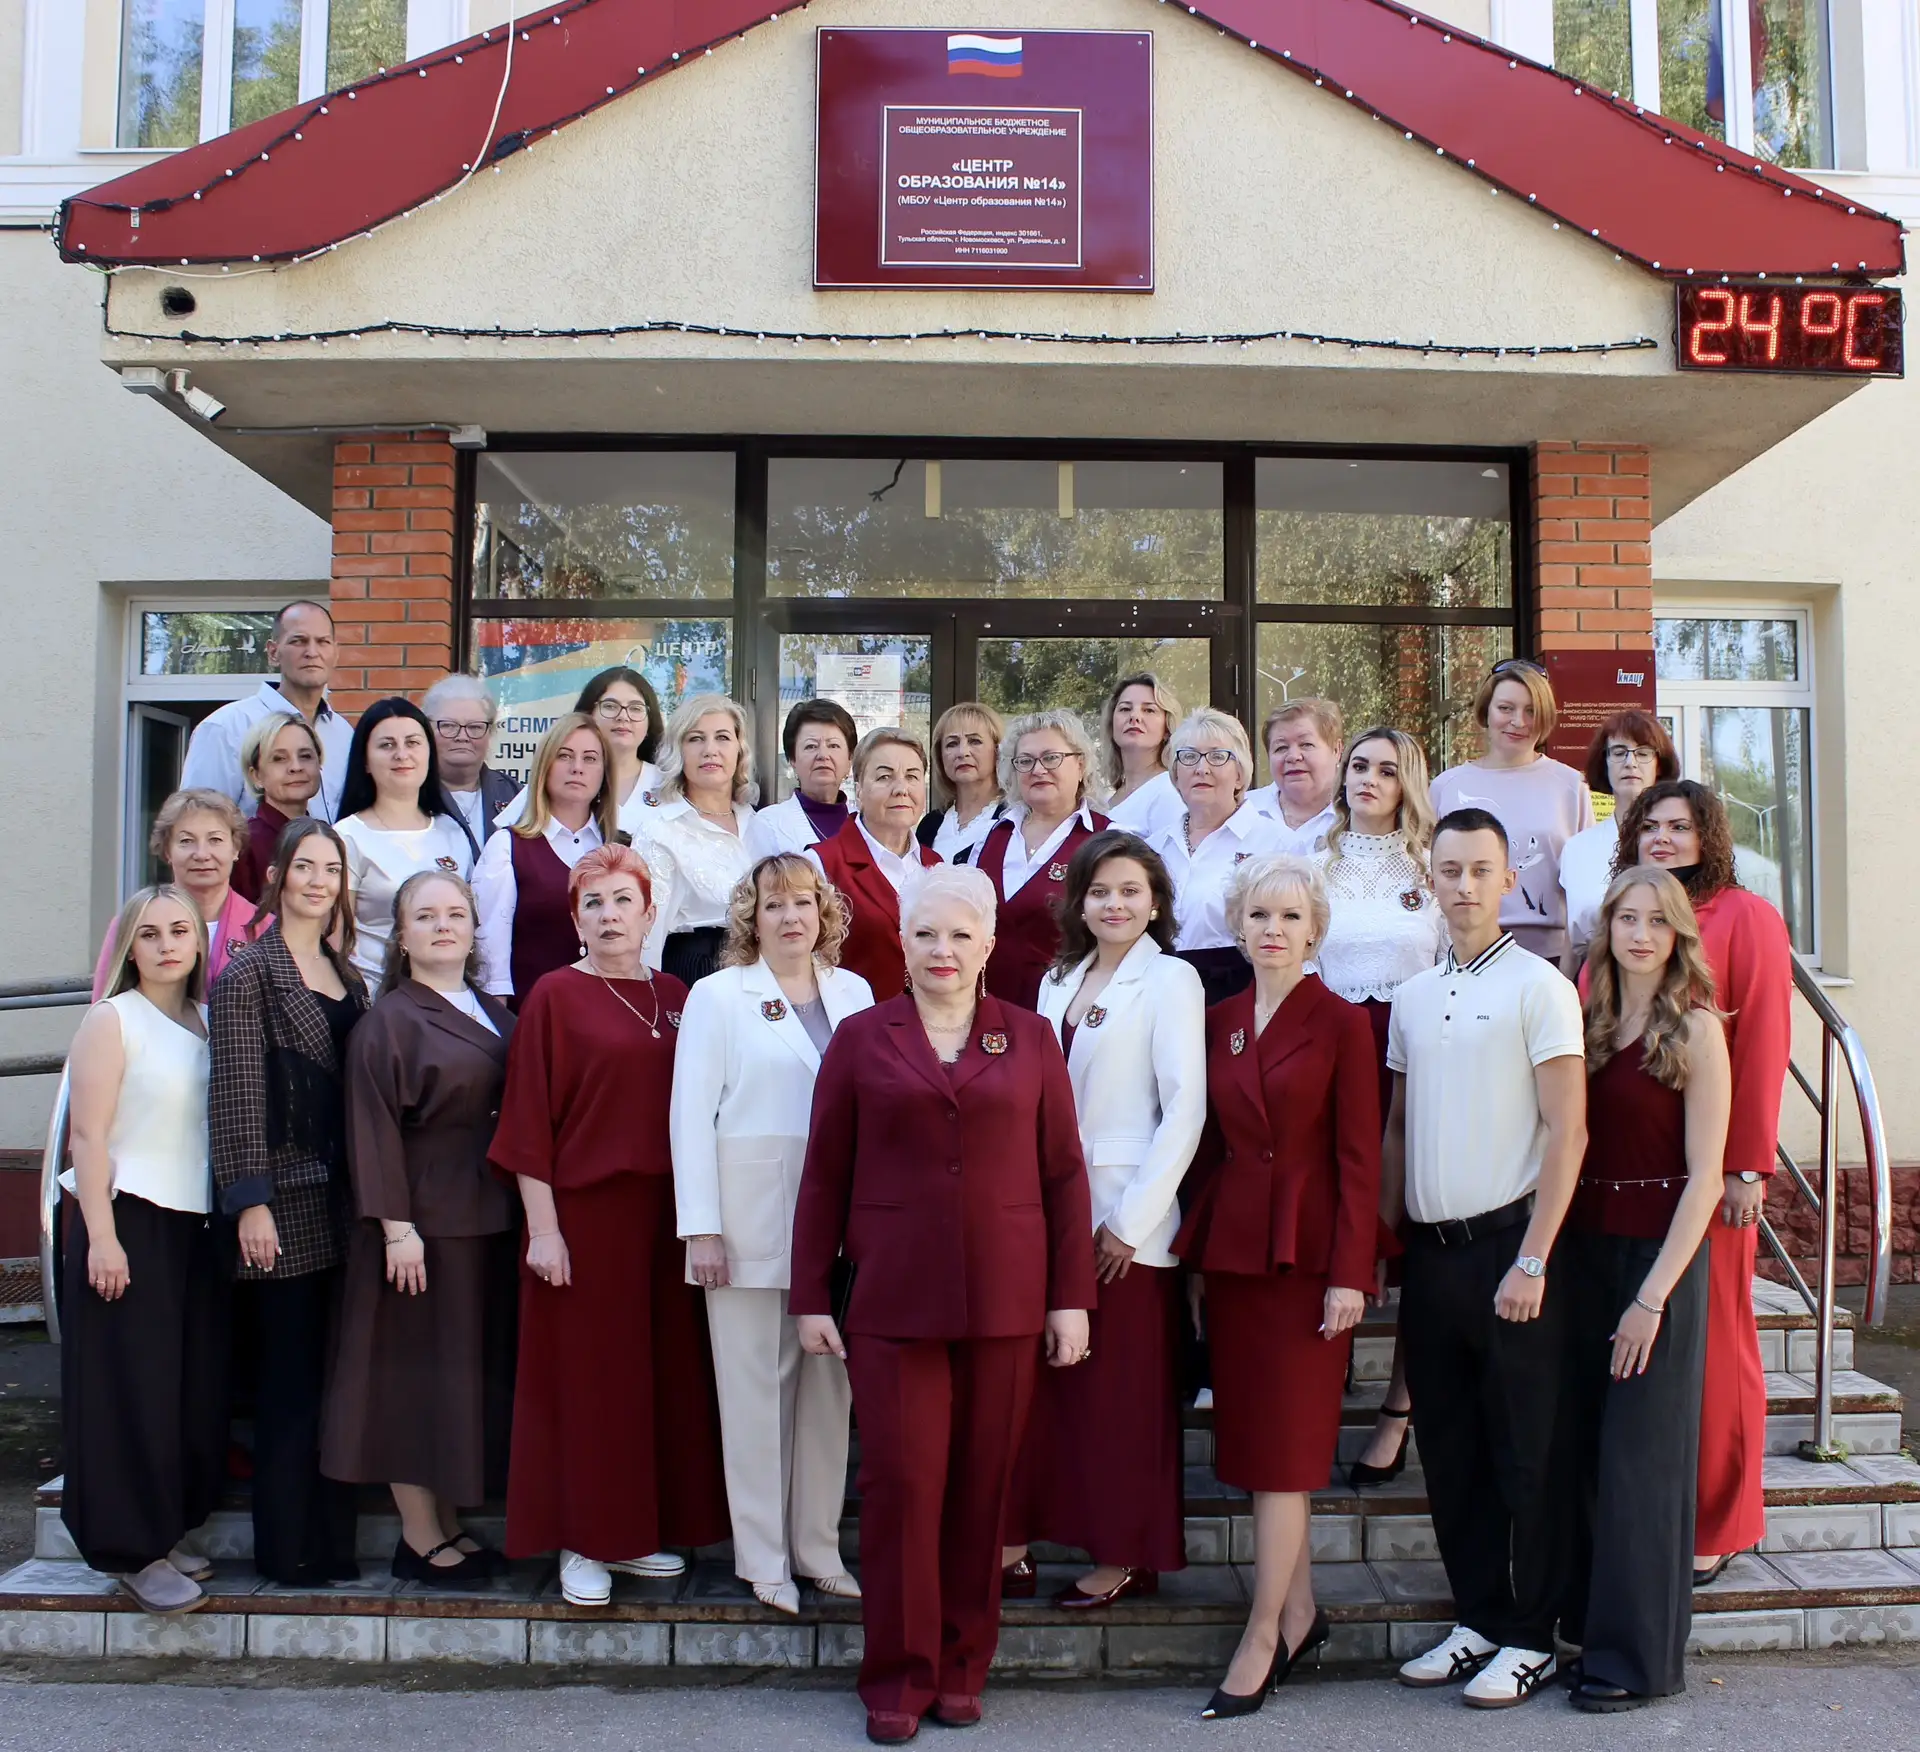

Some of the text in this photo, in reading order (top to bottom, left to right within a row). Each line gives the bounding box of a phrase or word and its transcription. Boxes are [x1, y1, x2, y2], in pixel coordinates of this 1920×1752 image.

[916, 117, 1050, 127] МУНИЦИПАЛЬНОЕ БЮДЖЕТНОЕ
[898, 126, 1067, 136] ОБЩЕОБРАЗОВАТЕЛЬНОЕ УЧРЕЖДЕНИЕ
[952, 159, 1014, 174] «ЦЕНТР
[898, 175, 1067, 190] ОБРАЗОВАНИЯ №14»
[897, 195, 1067, 208] (МБОУ «Центр образования №14»)
[897, 235, 926, 243] Тульская
[1691, 289, 1781, 362] 24
[656, 642, 717, 658] ЦЕНТР
[495, 743, 537, 759] ЛУЧ
